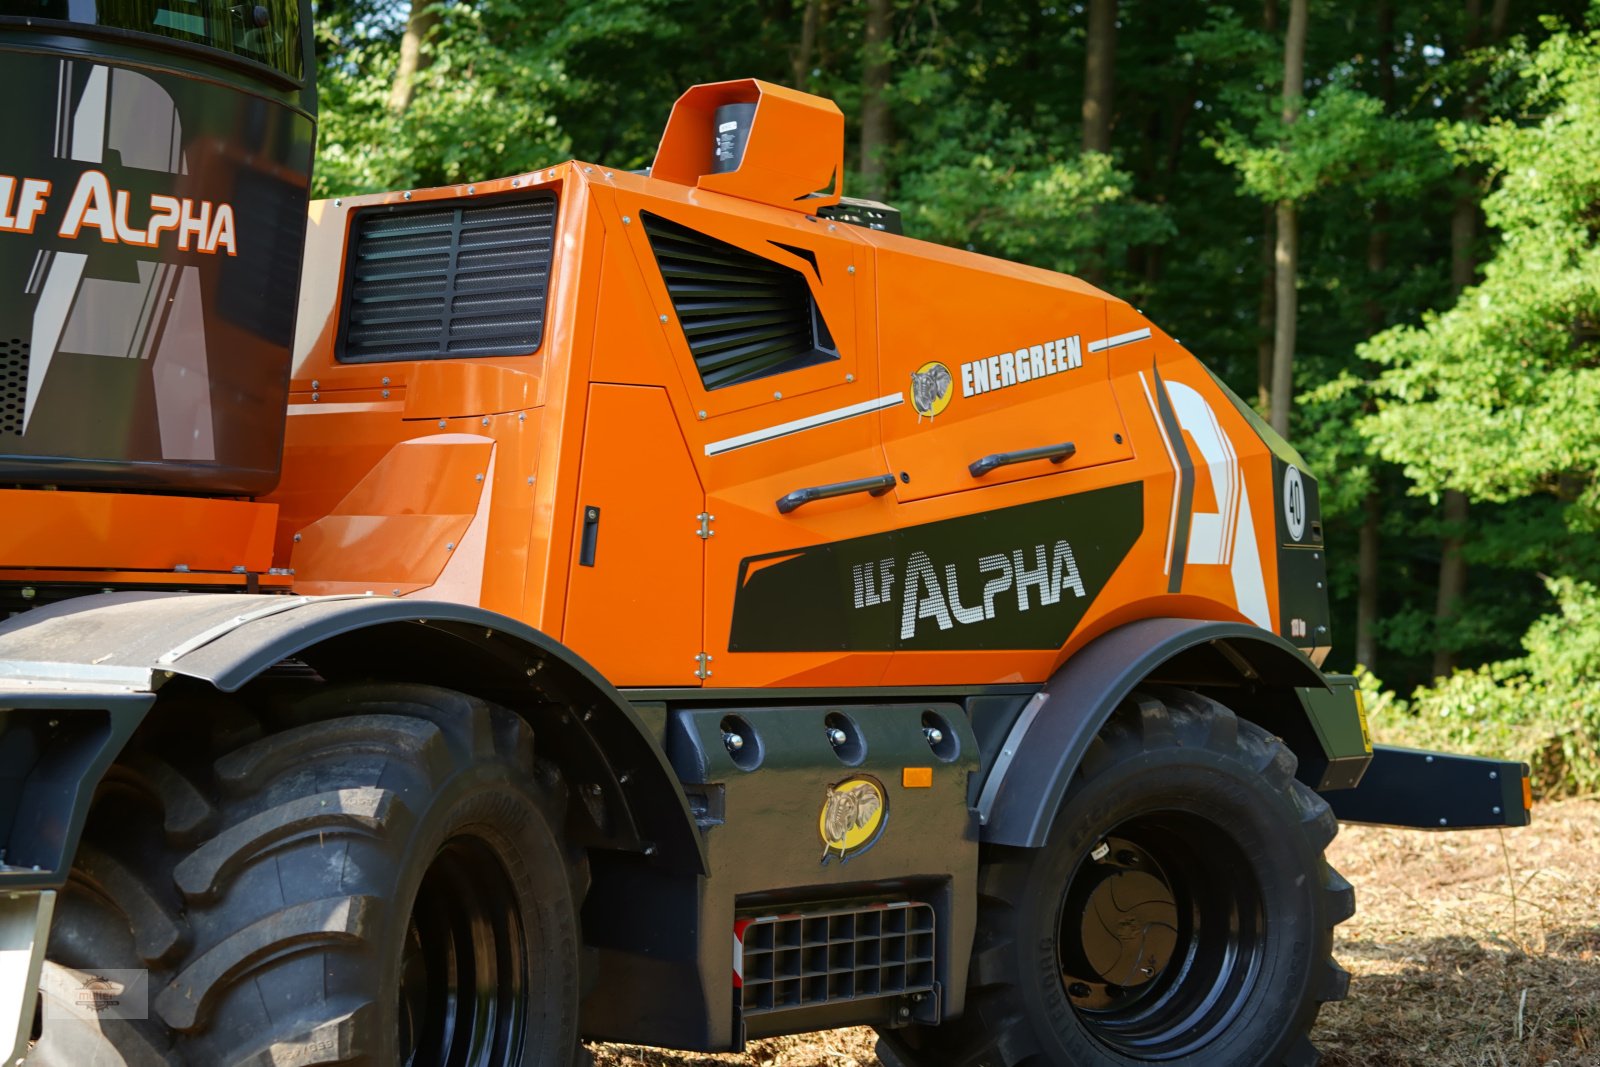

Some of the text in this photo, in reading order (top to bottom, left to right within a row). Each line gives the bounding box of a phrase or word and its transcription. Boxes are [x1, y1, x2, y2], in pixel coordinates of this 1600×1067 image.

[58, 169, 238, 257] ALPHA
[960, 334, 1083, 398] ENERGREEN
[1289, 479, 1302, 525] 40
[852, 539, 1087, 640] ILF ALPHA
